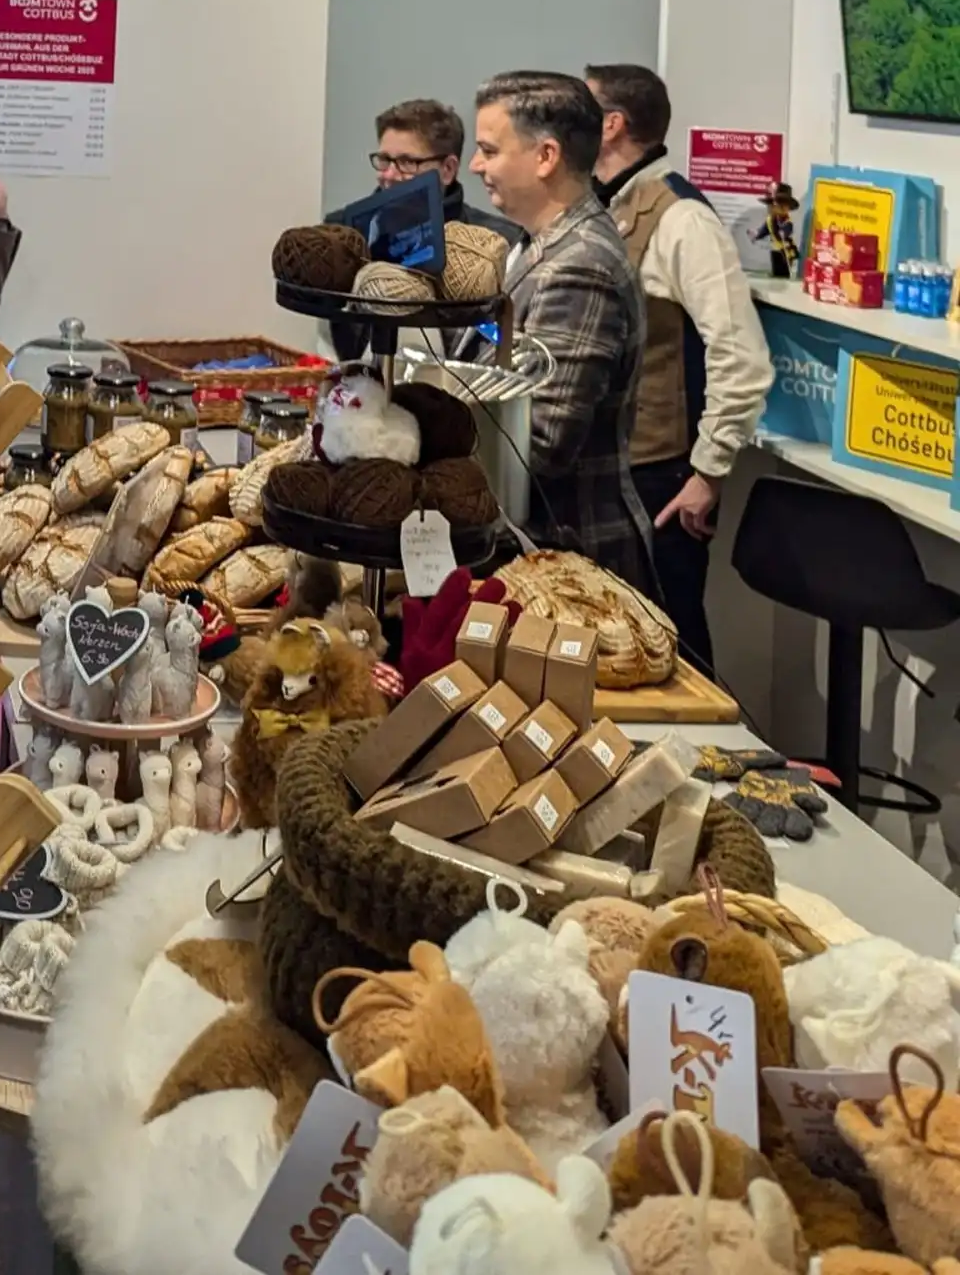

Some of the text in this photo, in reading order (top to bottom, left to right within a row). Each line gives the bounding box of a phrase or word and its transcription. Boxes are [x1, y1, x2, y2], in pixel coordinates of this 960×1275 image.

[23, 8, 75, 20] COTTBUS
[33, 43, 51, 52] AUS
[52, 44, 70, 53] DER
[780, 377, 836, 404] COTT
[884, 404, 955, 437] Cottbu
